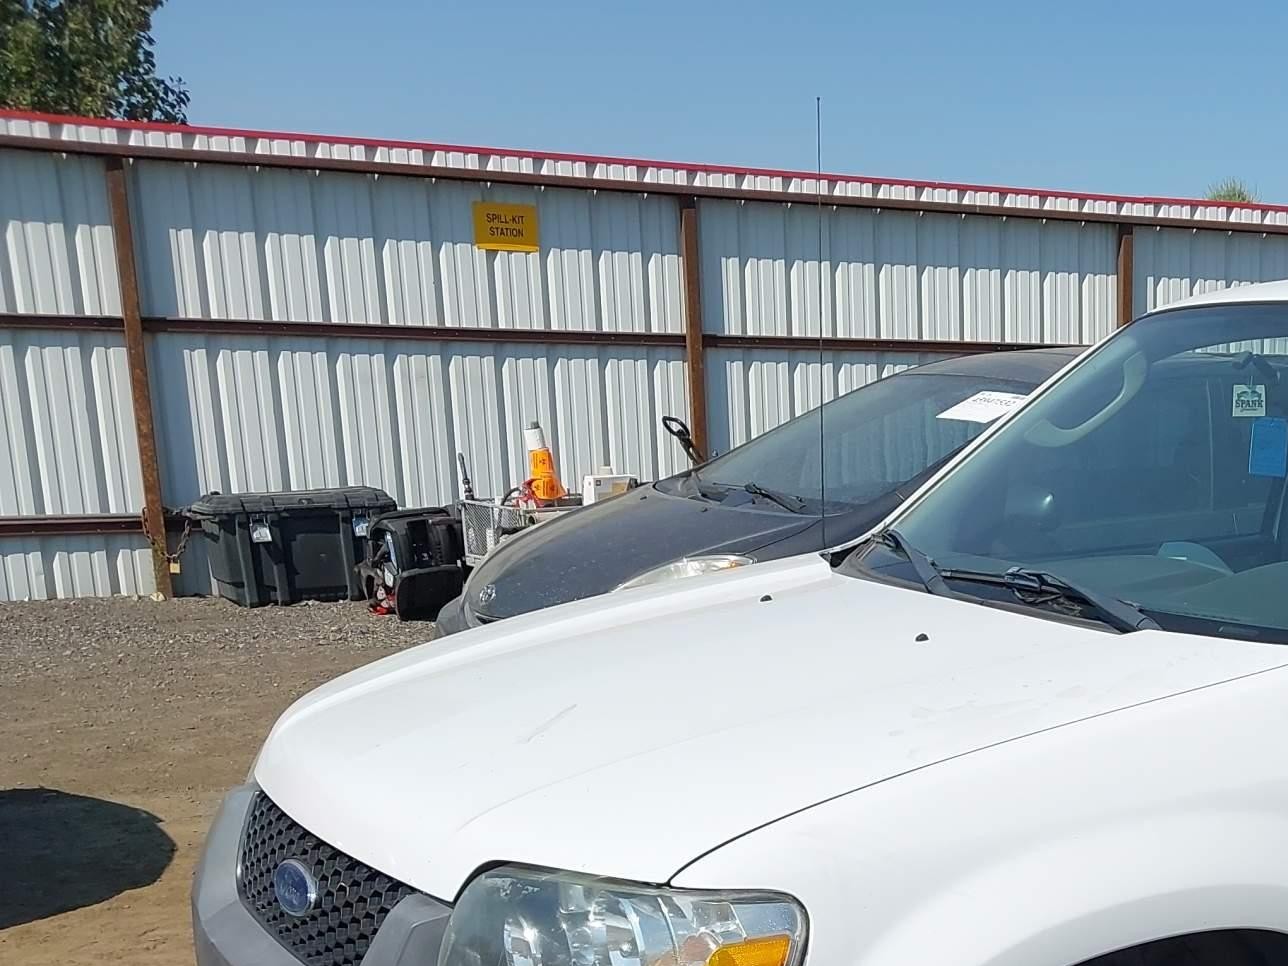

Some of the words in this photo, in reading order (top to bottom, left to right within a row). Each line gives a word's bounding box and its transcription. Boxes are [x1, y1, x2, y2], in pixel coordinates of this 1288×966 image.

[486, 213, 525, 224] SPILL-KIT
[489, 226, 524, 237] STATION
[1235, 399, 1264, 408] SPANK
